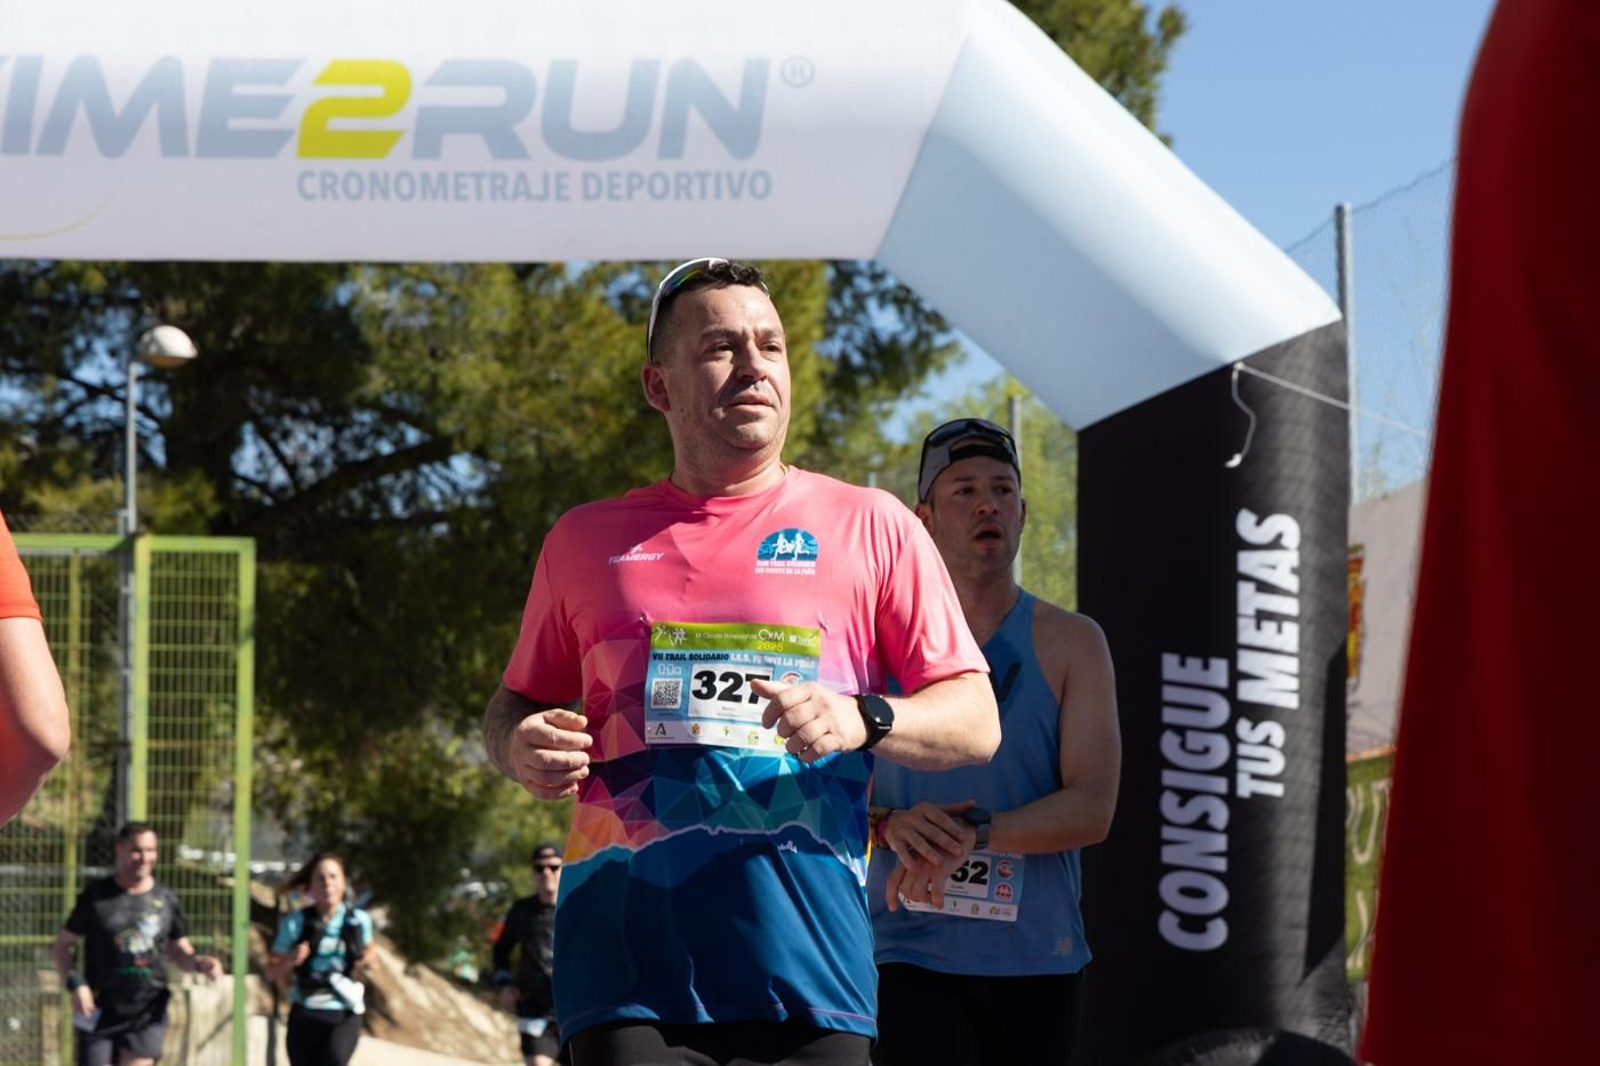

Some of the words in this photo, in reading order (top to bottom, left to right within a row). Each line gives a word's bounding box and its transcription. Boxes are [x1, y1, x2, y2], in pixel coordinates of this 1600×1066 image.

[0, 54, 769, 161] IME2RUN
[297, 169, 570, 203] CRONOMETRAJE
[582, 169, 773, 202] DEPORTIVO
[1235, 507, 1301, 711] METAS
[757, 641, 784, 652] 2025
[758, 628, 785, 642] CxM
[688, 653, 730, 661] SOLIDARIO
[691, 670, 770, 704] 327
[1235, 717, 1286, 799] TUS
[1158, 652, 1231, 952] CONSIGUE
